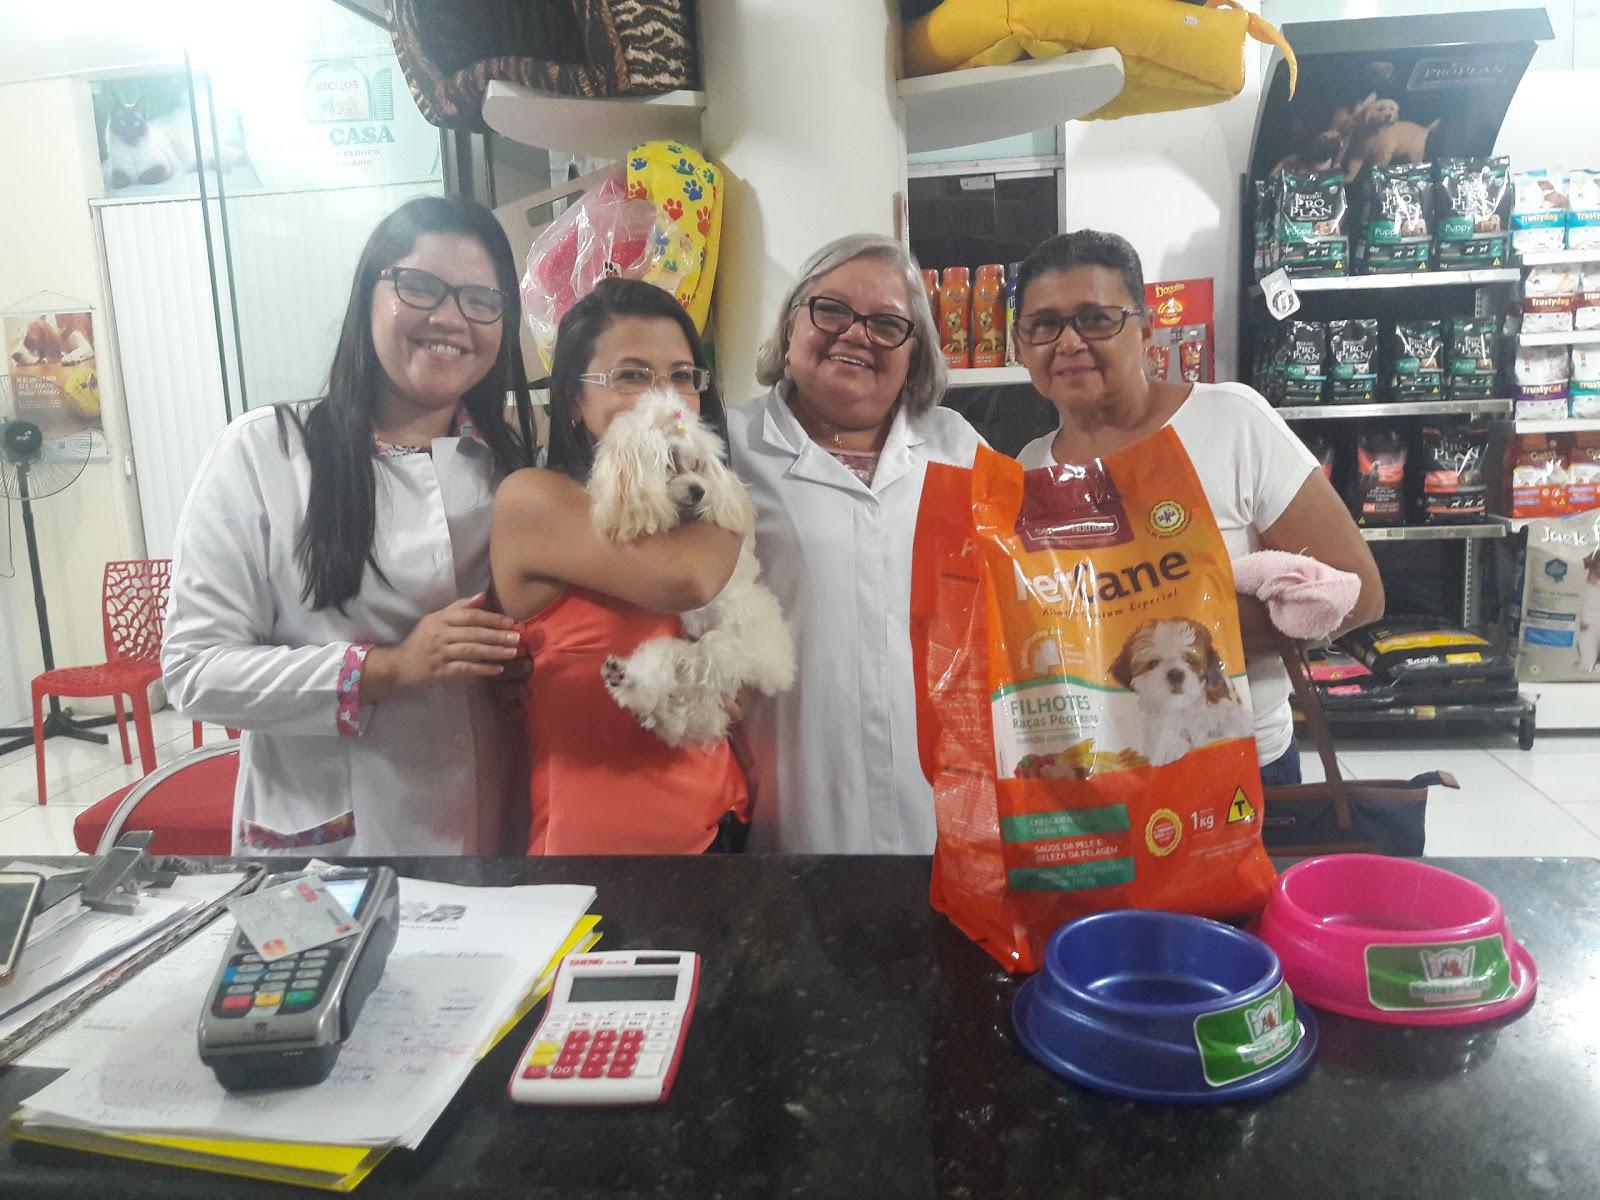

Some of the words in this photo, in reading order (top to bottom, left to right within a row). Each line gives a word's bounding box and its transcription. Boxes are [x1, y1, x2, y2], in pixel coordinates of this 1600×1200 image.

[329, 125, 396, 145] CASA
[1295, 199, 1325, 209] PRO
[1452, 197, 1498, 211] PLAN
[1290, 206, 1332, 217] PLAN
[1445, 223, 1472, 234] Puppy
[1532, 297, 1570, 307] Trustydog
[1297, 343, 1316, 354] PRO
[1343, 343, 1364, 354] PRO
[1294, 351, 1320, 361] PLAN
[1339, 351, 1369, 360] PLAN
[1541, 526, 1588, 547] Jack
[1130, 588, 1178, 611] Especial
[1010, 695, 1091, 716] FILHOTES
[1013, 717, 1046, 729] Raças
[1234, 799, 1245, 816] T
[1075, 839, 1095, 850] PELE
[1081, 846, 1118, 858] PELAGEM
